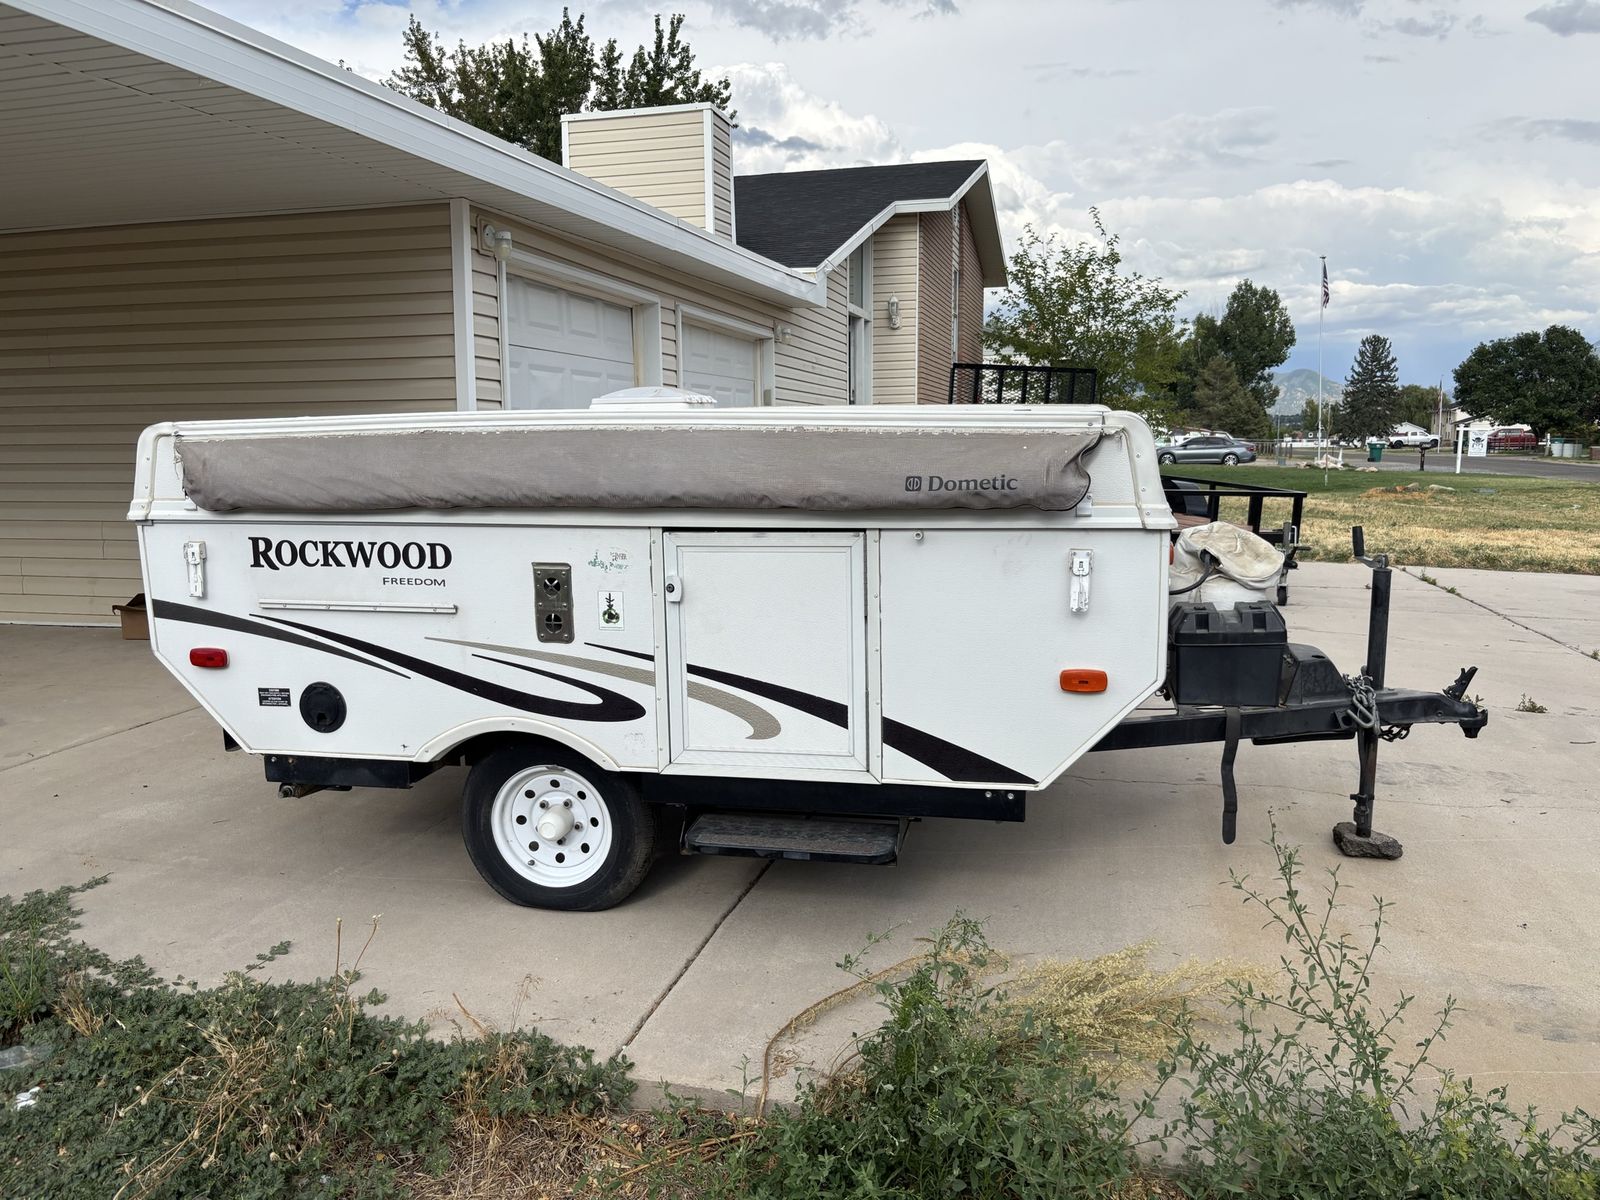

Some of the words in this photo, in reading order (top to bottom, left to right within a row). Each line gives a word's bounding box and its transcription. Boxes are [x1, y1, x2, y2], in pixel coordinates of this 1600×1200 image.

[928, 474, 1018, 492] Dometic
[248, 536, 453, 571] ROCKWOOD
[383, 577, 446, 587] FREEDOM
